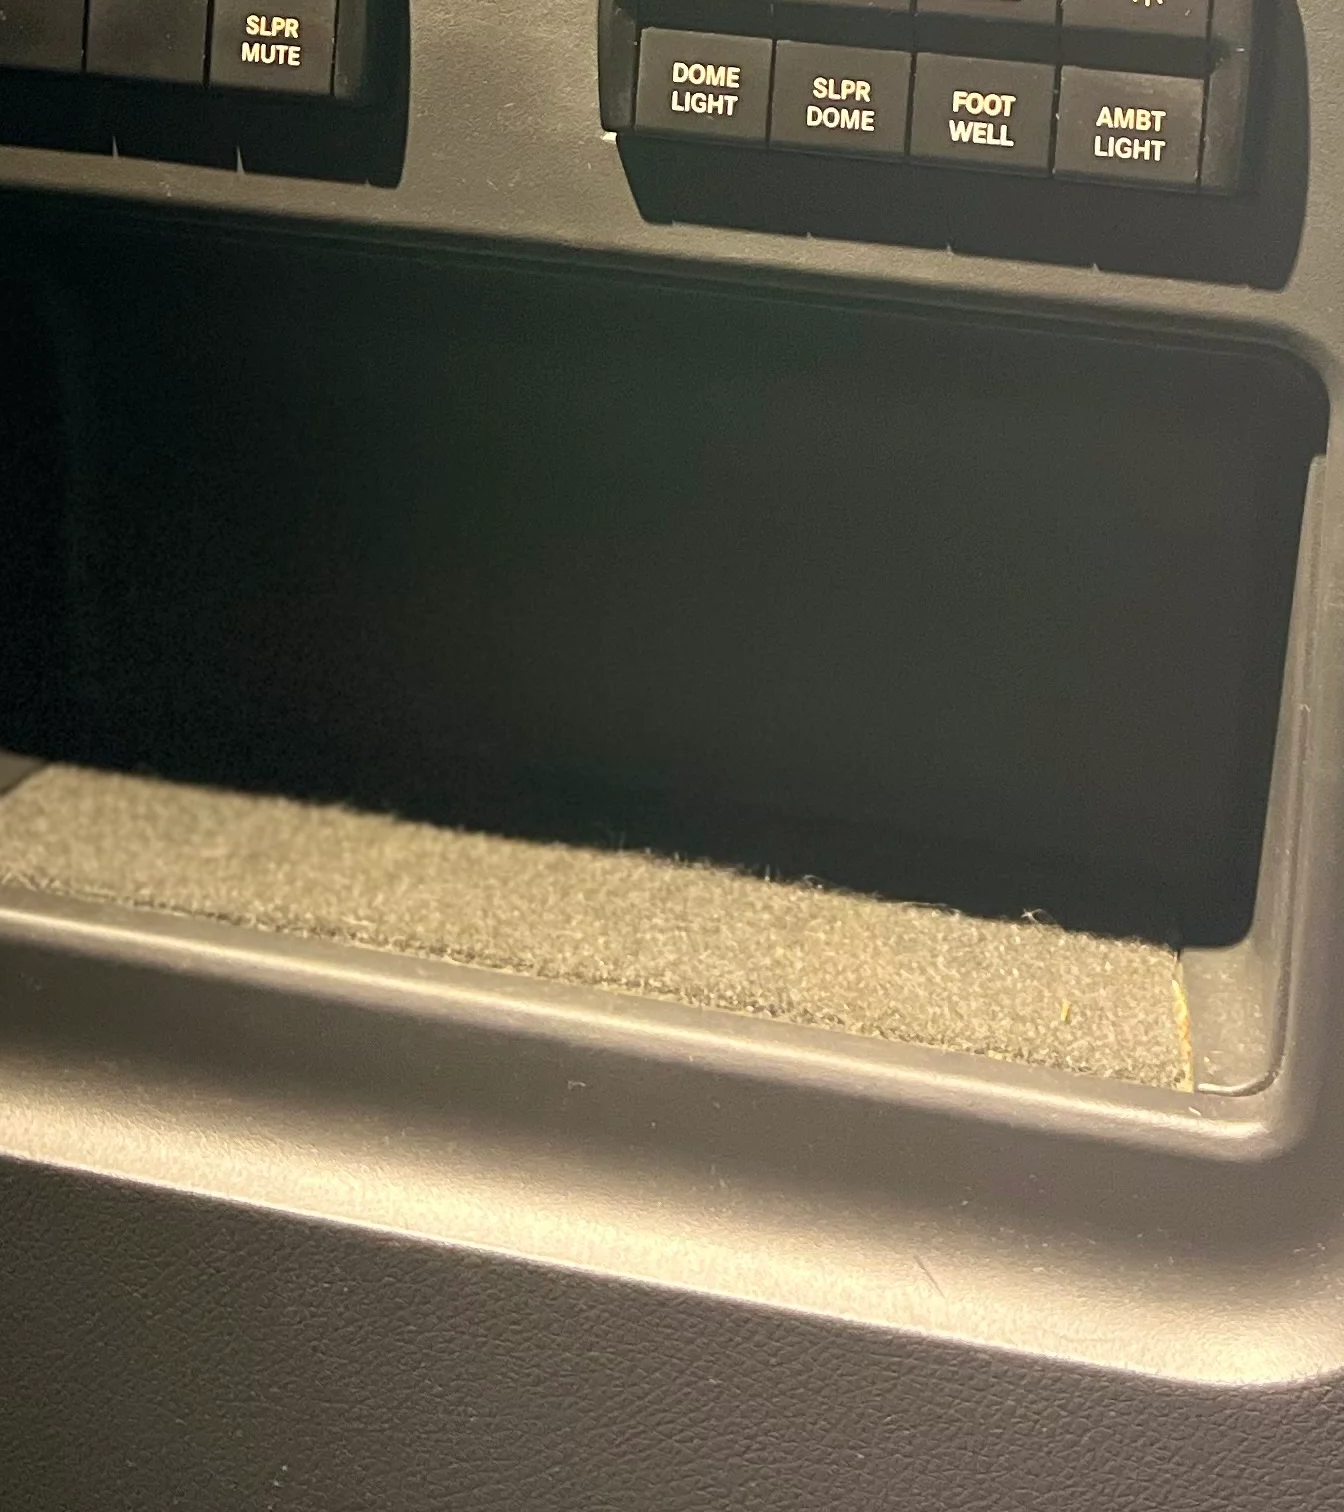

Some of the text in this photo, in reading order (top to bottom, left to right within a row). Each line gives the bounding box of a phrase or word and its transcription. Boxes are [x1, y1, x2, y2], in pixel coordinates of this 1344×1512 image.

[245, 14, 299, 39] SLPR
[241, 42, 301, 66] MUTE
[672, 61, 741, 88] DOME
[671, 90, 738, 116] LIGHT
[813, 76, 871, 103] SLPR
[952, 90, 1016, 117] FOOT
[806, 105, 875, 132] DOME
[1096, 106, 1166, 132] AMBT
[949, 120, 1014, 147] WELL
[1094, 135, 1166, 162] LIGHT
